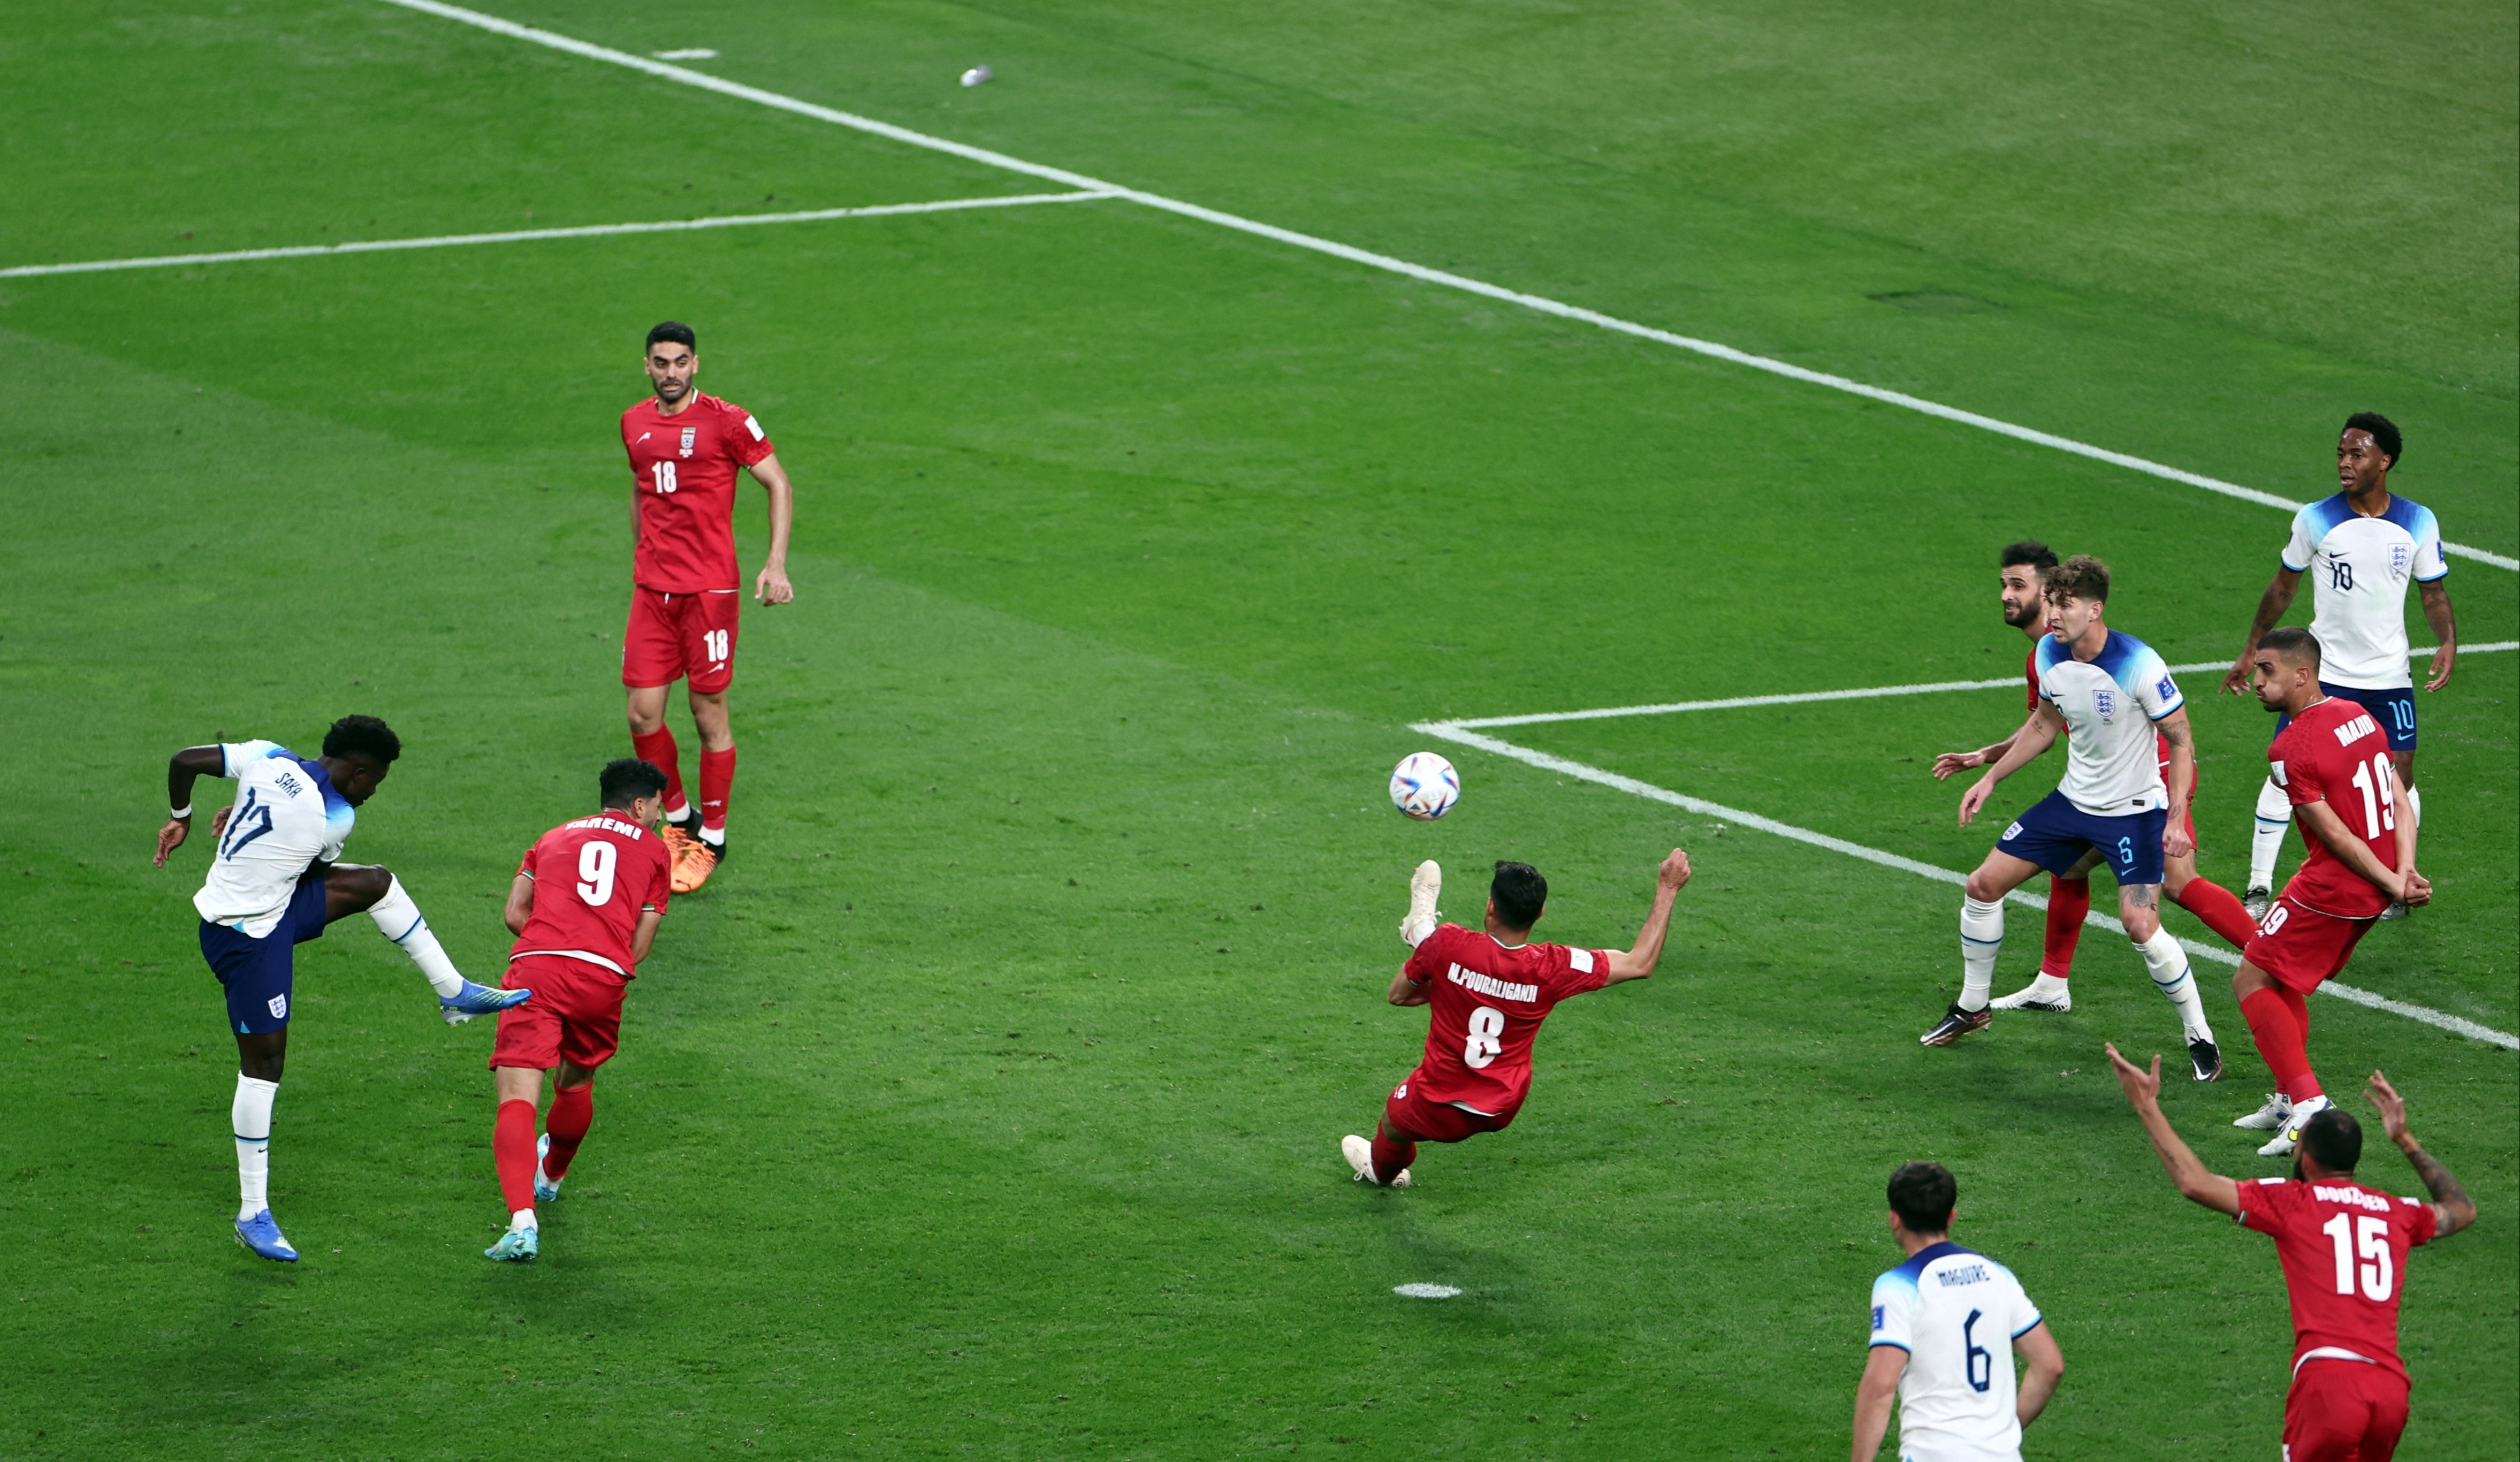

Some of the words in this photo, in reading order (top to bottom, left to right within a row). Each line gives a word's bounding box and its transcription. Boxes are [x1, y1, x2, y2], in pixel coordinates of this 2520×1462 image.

[652, 461, 677, 493] 18
[2329, 562, 2352, 591] 10
[703, 629, 728, 662] 18
[2333, 714, 2377, 747] MAJID
[2388, 699, 2415, 730] 10
[275, 773, 303, 798] SAKA
[2351, 752, 2395, 840] 19
[221, 786, 274, 862] 17
[565, 817, 643, 841] TAREMI
[576, 841, 618, 907] 9
[2260, 901, 2289, 935] 19
[1447, 962, 1539, 1003] M.POURALIGANJI
[1464, 1006, 1505, 1069] 8
[2312, 1185, 2391, 1212] ROUZEH
[2323, 1212, 2394, 1302] 15
[1936, 1265, 1990, 1287] MAGUIRE
[1963, 1308, 1991, 1393] 6
